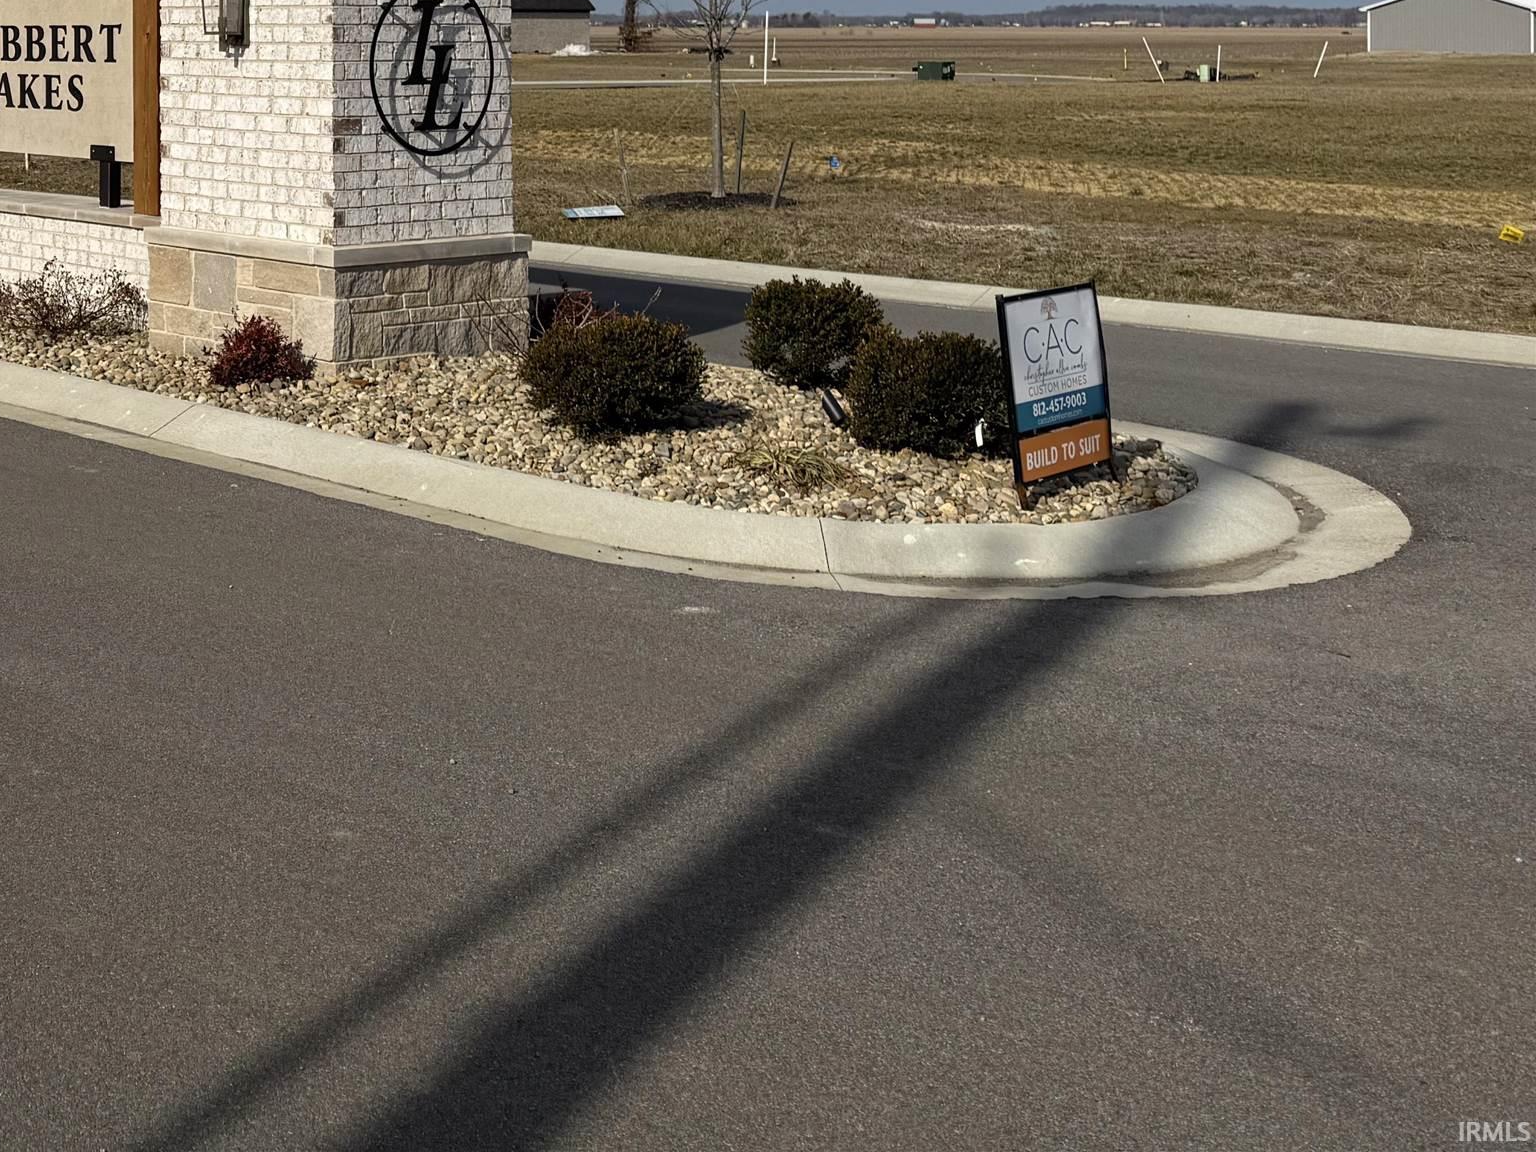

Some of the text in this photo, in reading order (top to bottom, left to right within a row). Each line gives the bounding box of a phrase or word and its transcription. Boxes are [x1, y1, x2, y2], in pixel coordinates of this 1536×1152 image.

[1028, 374, 1088, 397] CUSTOM HOMES
[1032, 391, 1087, 417] 812-457-9003
[1026, 433, 1101, 471] BUILD TO SUIT
